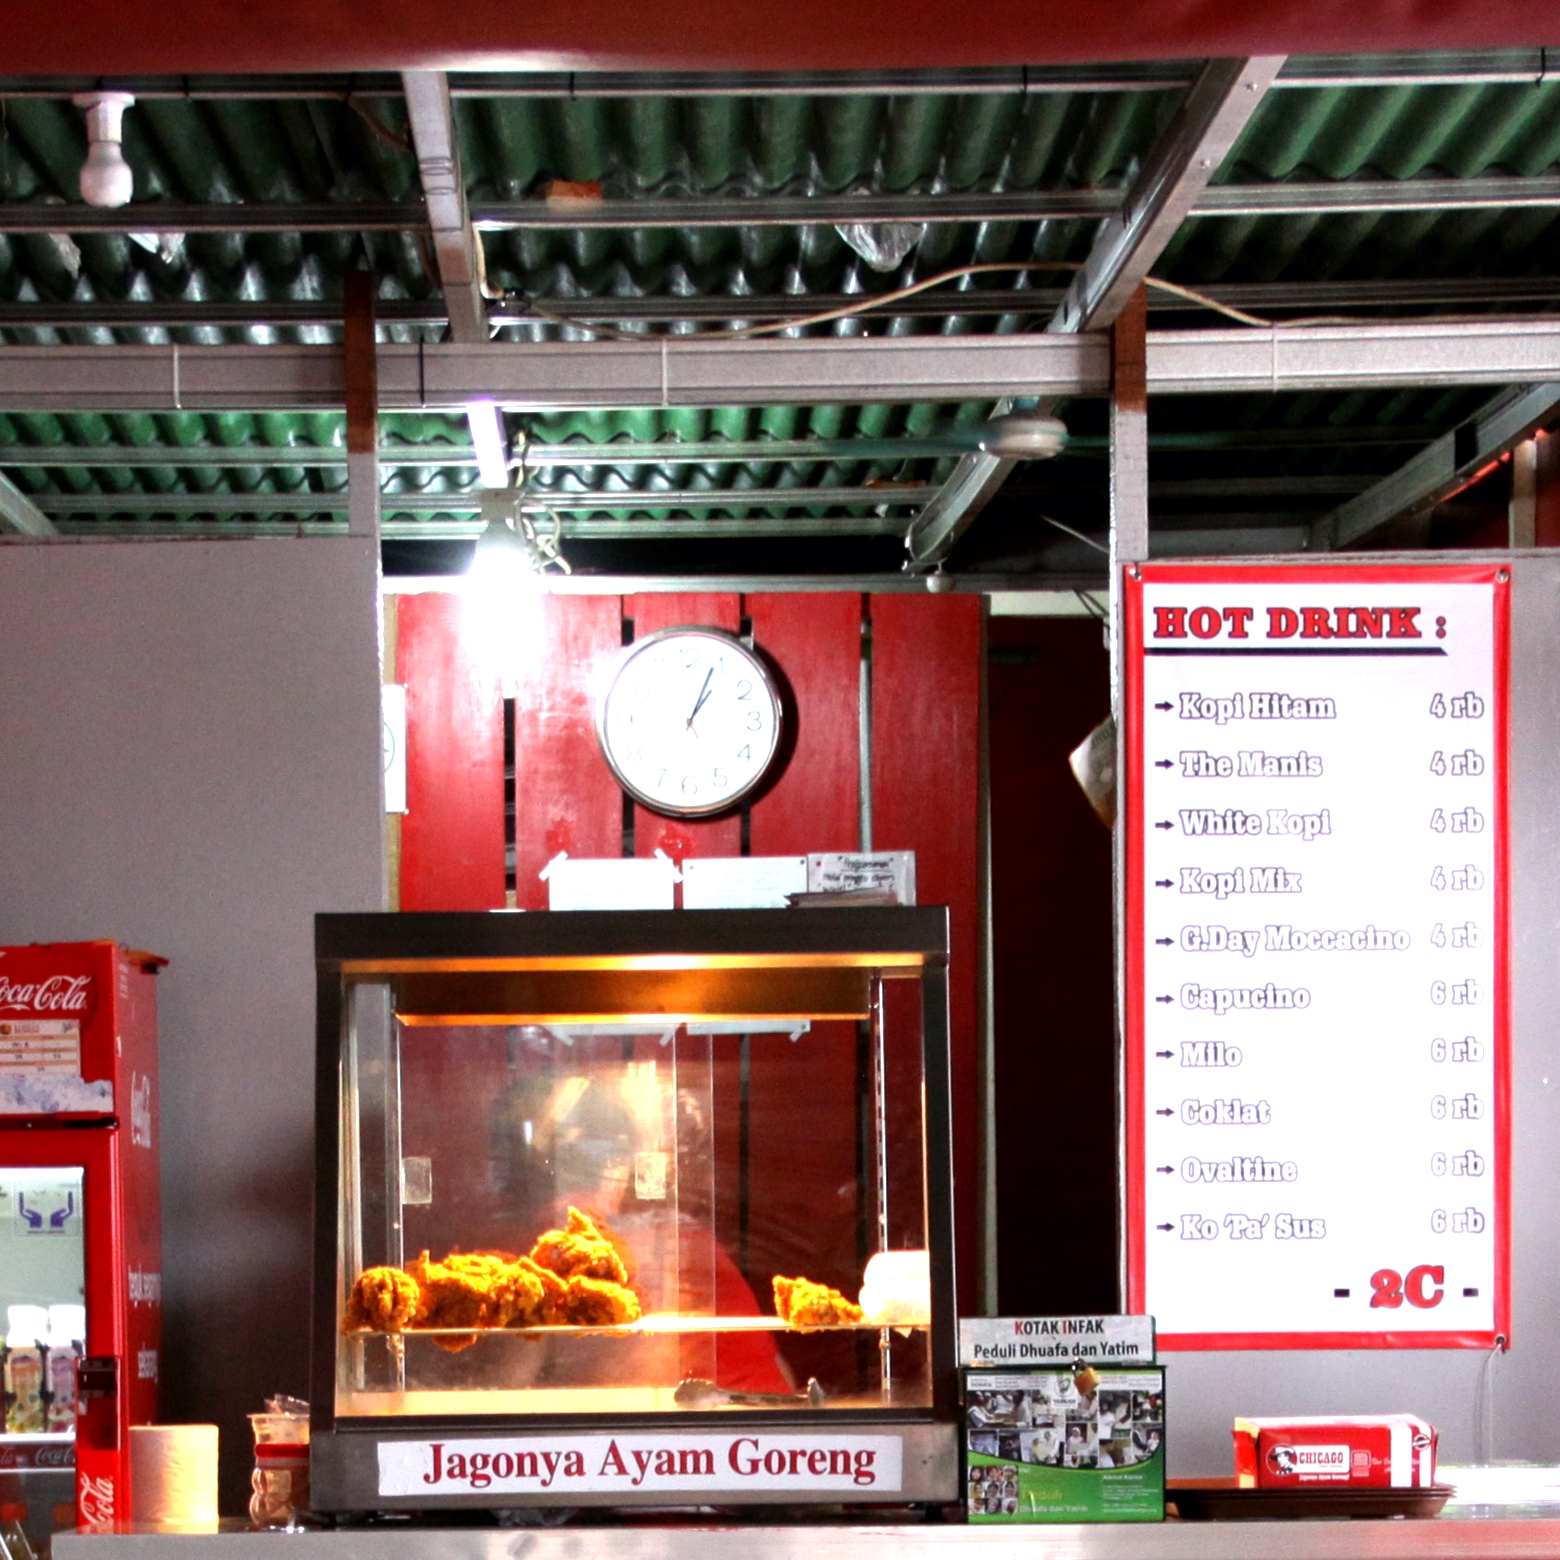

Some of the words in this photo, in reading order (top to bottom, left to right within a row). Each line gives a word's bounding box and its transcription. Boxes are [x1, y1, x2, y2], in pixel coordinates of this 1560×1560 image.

[1153, 606, 1253, 639] HOT
[1266, 606, 1422, 639] DRINK
[736, 679, 753, 701] 2
[1179, 692, 1244, 725] Kopi
[1249, 692, 1337, 719] Hitam
[1430, 694, 1445, 718] 4
[1451, 692, 1484, 718] rb
[746, 710, 763, 731] 3
[736, 743, 752, 763] 4
[1179, 750, 1233, 777] The
[1238, 750, 1323, 777] Manis
[1430, 752, 1445, 776] 4
[1451, 750, 1484, 776] rb
[681, 775, 698, 796] 6
[712, 767, 728, 788] 5
[1179, 809, 1262, 835] White
[1267, 809, 1331, 841] Kopi
[1430, 809, 1445, 833] 4
[1451, 807, 1484, 833] rb
[1179, 867, 1244, 900] Kopi
[1250, 867, 1302, 893] Mix
[1430, 866, 1445, 891] 4
[1451, 864, 1484, 891] rb
[1180, 925, 1260, 958] G.Day
[1265, 925, 1410, 952] Moccacino
[1430, 924, 1445, 948] 4
[1451, 922, 1484, 948] rb
[1180, 982, 1311, 1015] Capucino
[1430, 980, 1445, 1005] 6
[1451, 979, 1484, 1005] rb
[1180, 1041, 1242, 1067] Milo
[1430, 1038, 1445, 1062] 6
[1451, 1036, 1484, 1063] rb
[1180, 1099, 1271, 1125] Coklat
[1430, 1095, 1445, 1119] 6
[1451, 1093, 1484, 1120] rb
[1180, 1156, 1298, 1183] Ovaltine
[1430, 1152, 1445, 1177] 6
[1451, 1150, 1484, 1177] rb
[1180, 1214, 1218, 1240] Ko
[1275, 1213, 1327, 1240] Sus
[1430, 1210, 1445, 1234] 6
[1451, 1208, 1484, 1234] rb
[1369, 1264, 1445, 1309] 2C
[1014, 1320, 1060, 1336] KOTAK
[1062, 1319, 1104, 1335] INFAK
[974, 1343, 1016, 1359] Peduli
[1020, 1342, 1069, 1358] Dhuafa
[1071, 1341, 1097, 1356] dan
[1100, 1340, 1139, 1356] Yatim
[423, 1443, 586, 1488] Jagonya
[598, 1439, 716, 1486] Ayam
[728, 1437, 877, 1486] Goreng
[1299, 1451, 1344, 1465] CHICAGO
